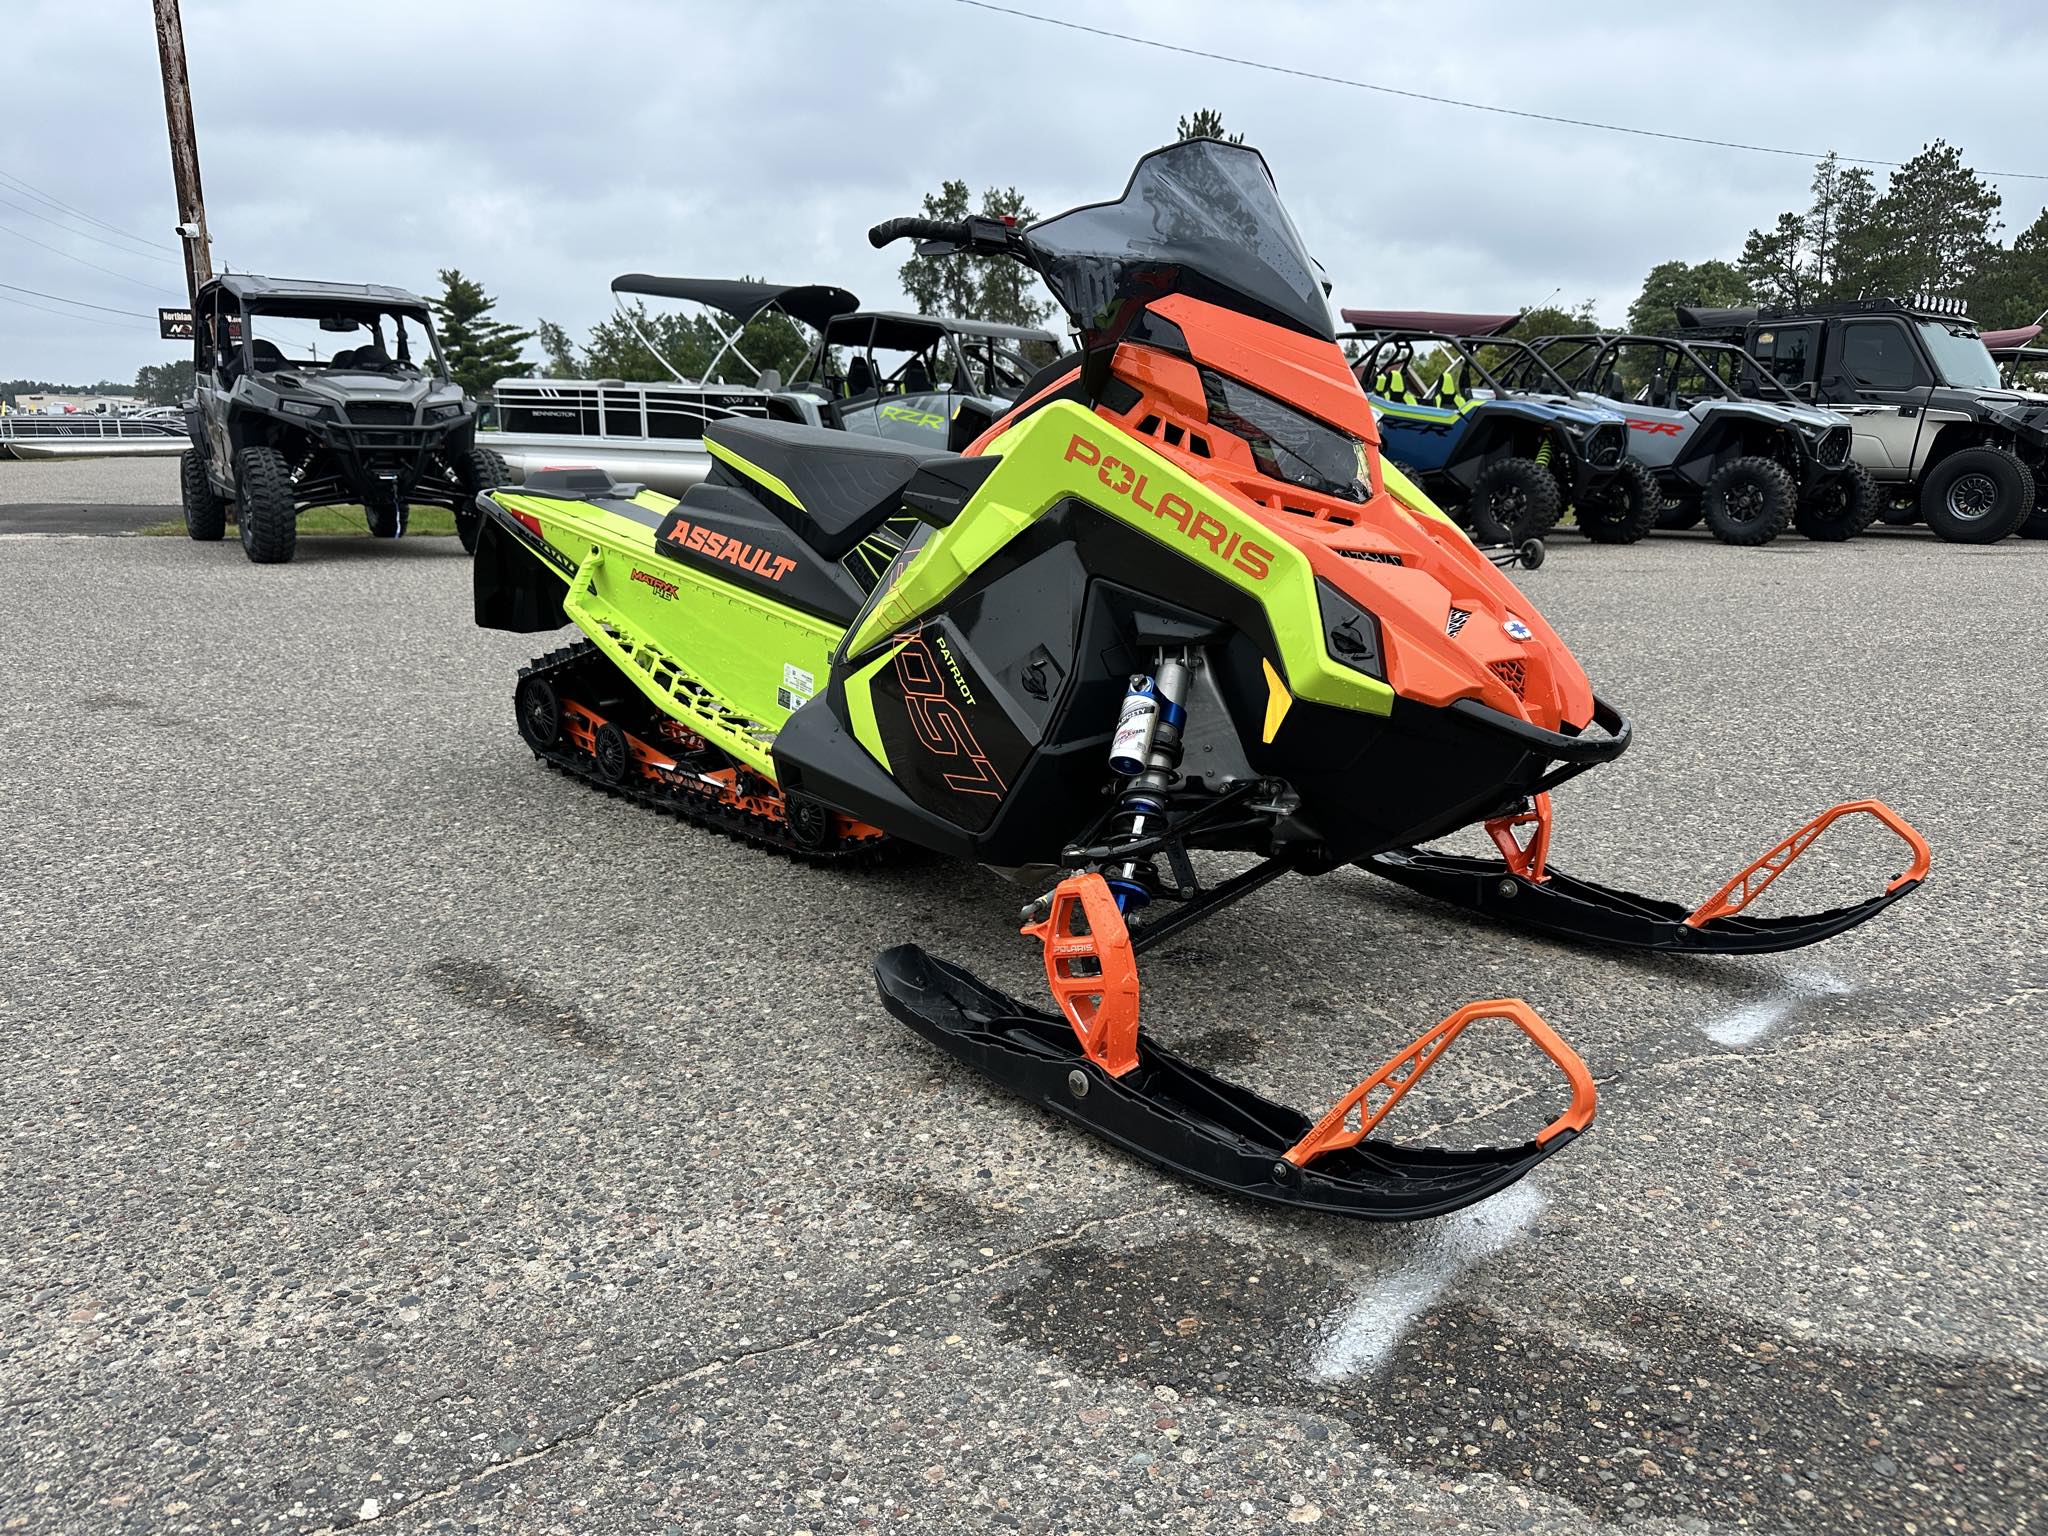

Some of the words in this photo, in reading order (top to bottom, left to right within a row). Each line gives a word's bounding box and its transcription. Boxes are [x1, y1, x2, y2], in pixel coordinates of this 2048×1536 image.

[162, 311, 192, 321] Northlan
[880, 405, 944, 429] RZR
[1625, 417, 1684, 437] ZR
[1064, 434, 1275, 580] POLARIS
[667, 519, 797, 582] ASSAULT
[630, 567, 680, 600] MATRYX
[653, 586, 672, 601] 146
[936, 636, 976, 705] PATRIOT
[1054, 943, 1094, 953] POLARIS
[1300, 1107, 1342, 1149] POLARIS
